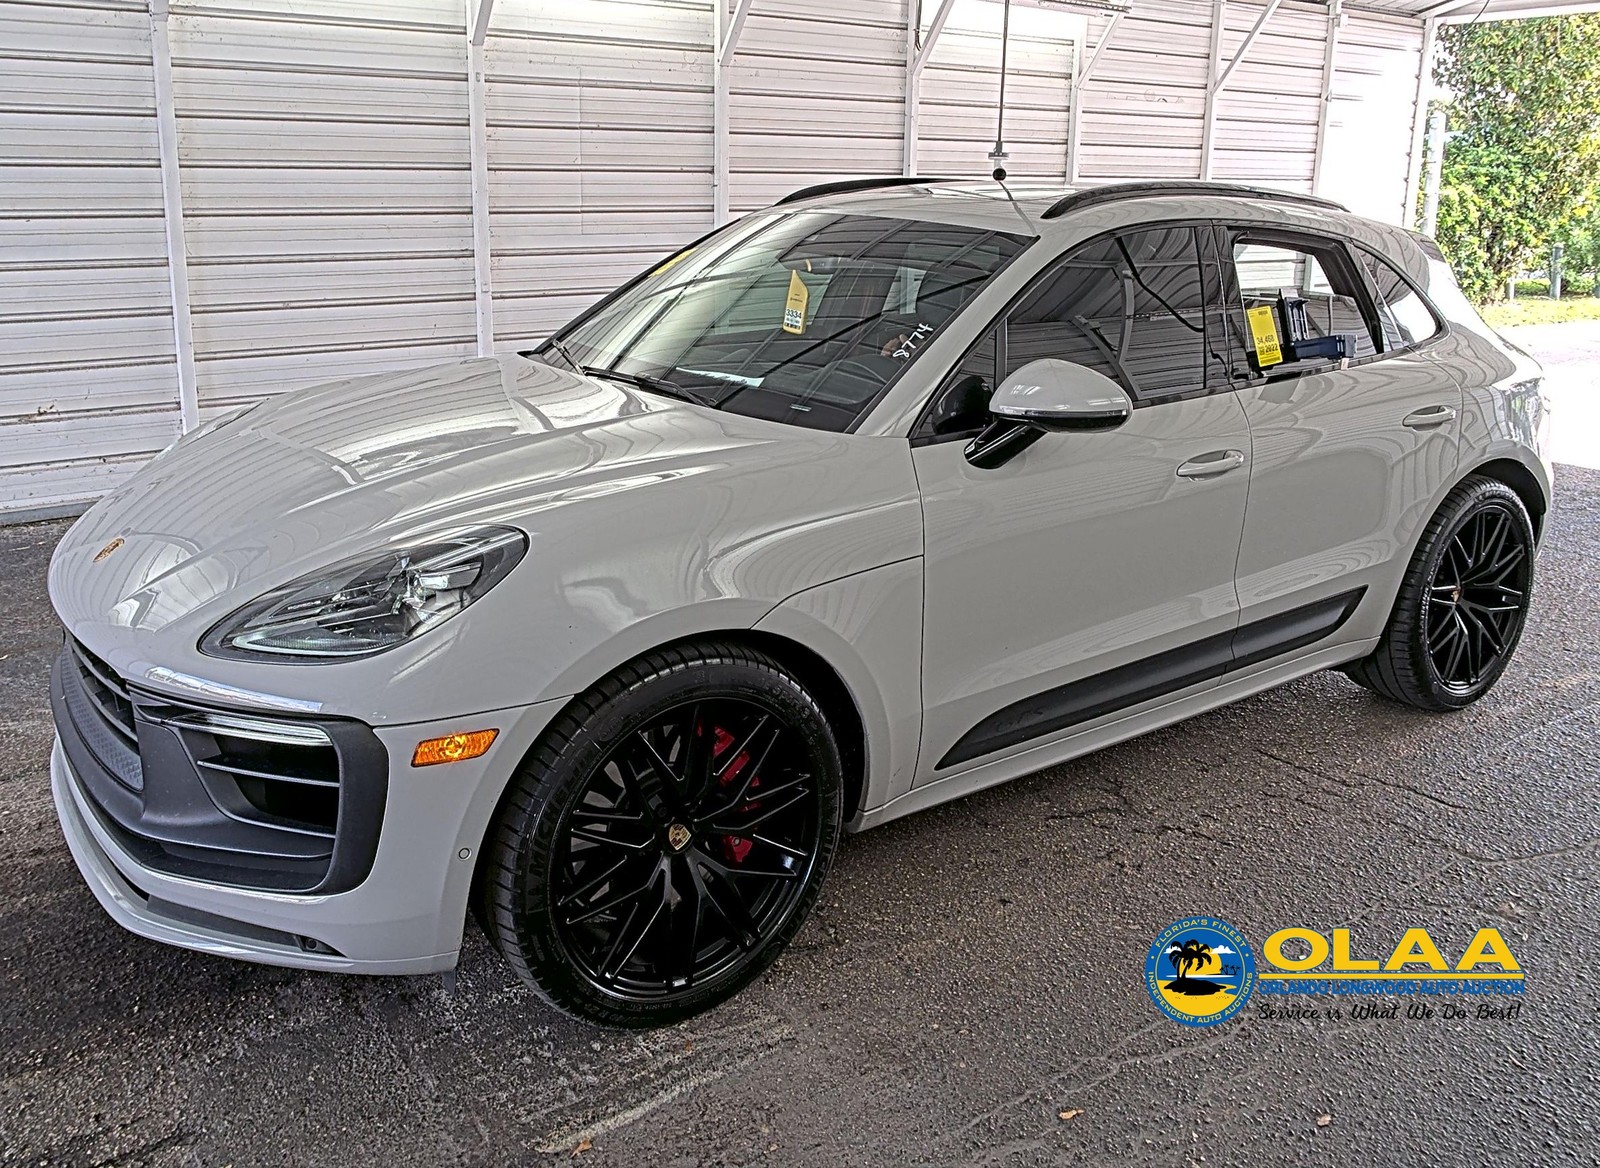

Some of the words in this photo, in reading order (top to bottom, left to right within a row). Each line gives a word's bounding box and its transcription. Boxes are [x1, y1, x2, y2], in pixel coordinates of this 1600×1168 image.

[785, 308, 802, 319] 3334
[892, 323, 934, 359] 8774
[1265, 343, 1278, 353] 2022
